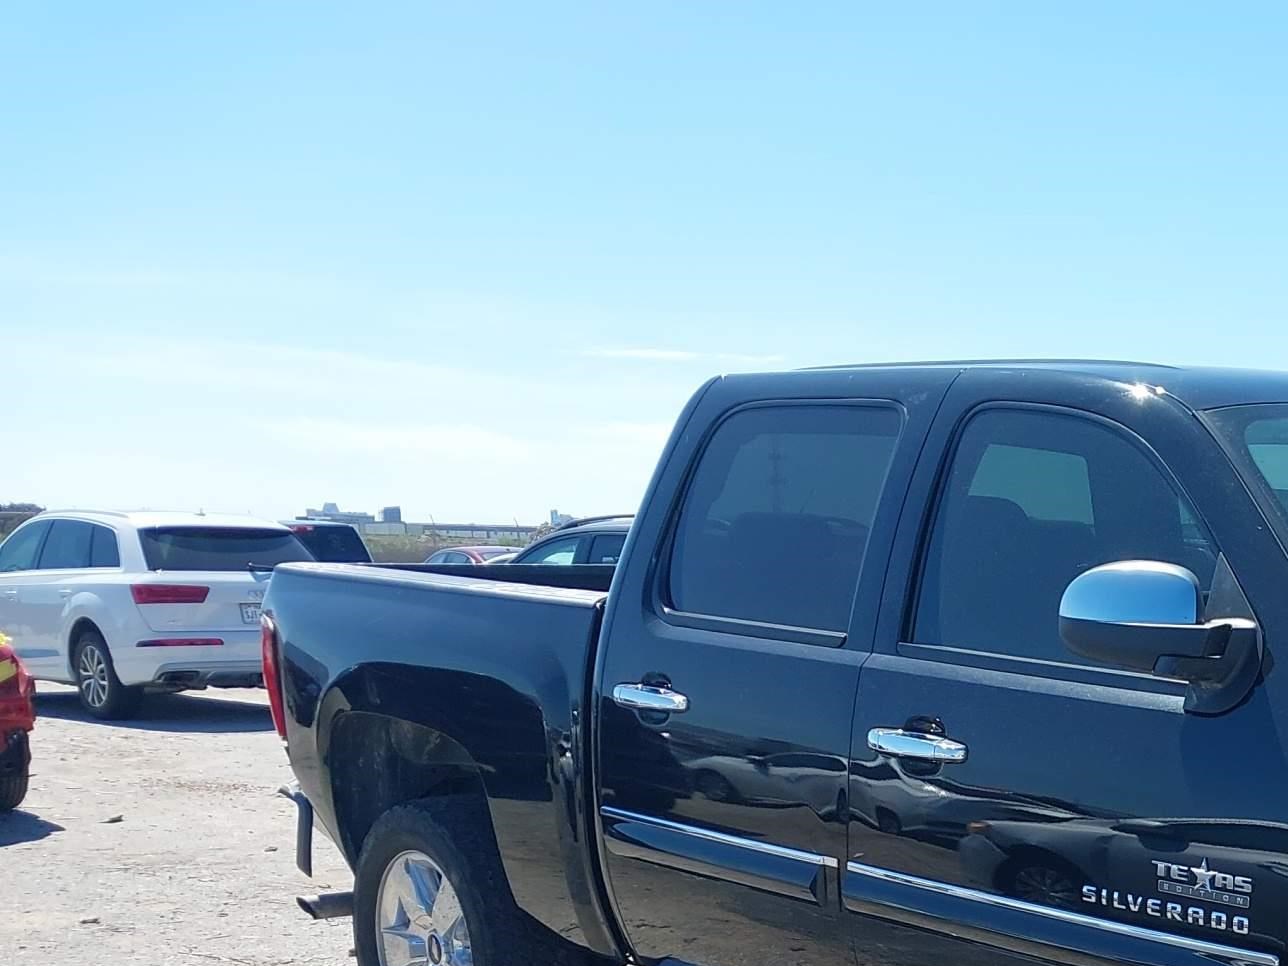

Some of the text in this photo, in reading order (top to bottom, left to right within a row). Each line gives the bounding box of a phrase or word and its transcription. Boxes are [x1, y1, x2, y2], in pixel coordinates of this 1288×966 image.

[1152, 857, 1252, 893] TEXAS
[1081, 885, 1249, 935] SILVERADO
[1162, 883, 1245, 905] EDITION
